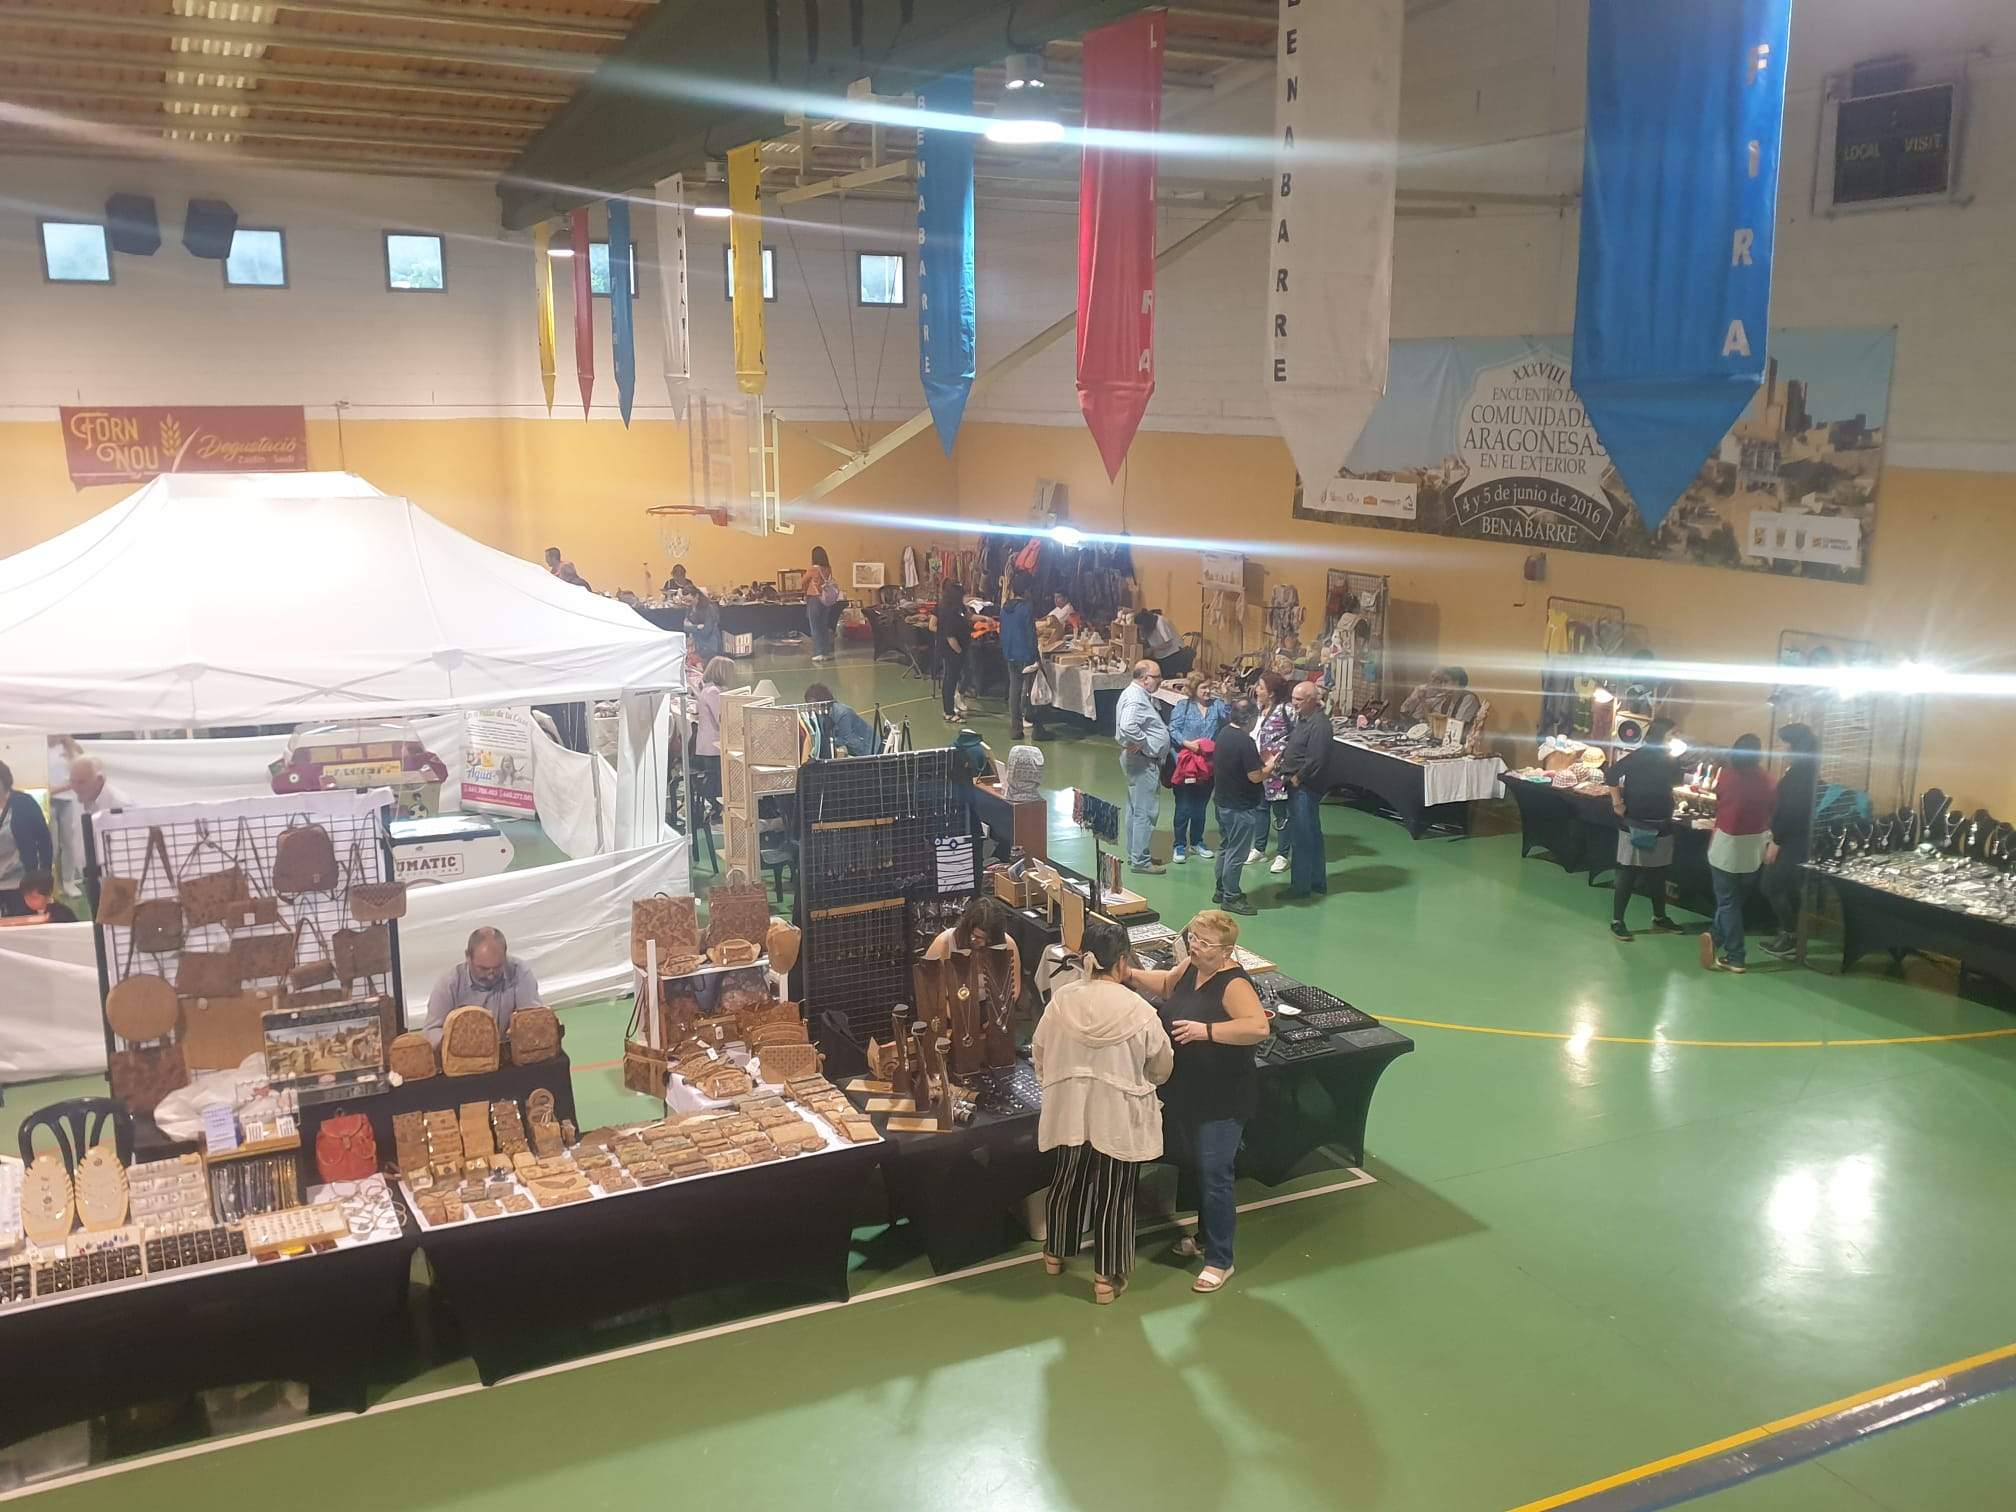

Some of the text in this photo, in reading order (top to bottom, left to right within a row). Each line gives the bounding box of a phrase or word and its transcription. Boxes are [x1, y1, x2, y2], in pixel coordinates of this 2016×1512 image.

[1273, 0, 1301, 382] ENABARRE
[1721, 43, 1770, 357] FIRA
[916, 95, 932, 374] BENABARRE
[1513, 362, 1567, 384] XXXVIII
[70, 412, 139, 450] FORN
[1471, 404, 1593, 428] COMUNIDADE
[1464, 426, 1607, 456] ARAGONESAS
[97, 442, 159, 479] NOU
[1480, 452, 1587, 475] EN EL EXTERIOR
[1462, 482, 1601, 525] 4 y 5 de junio de 2016
[1481, 516, 1579, 544] BENABARRE
[396, 856, 457, 873] UMATIC
